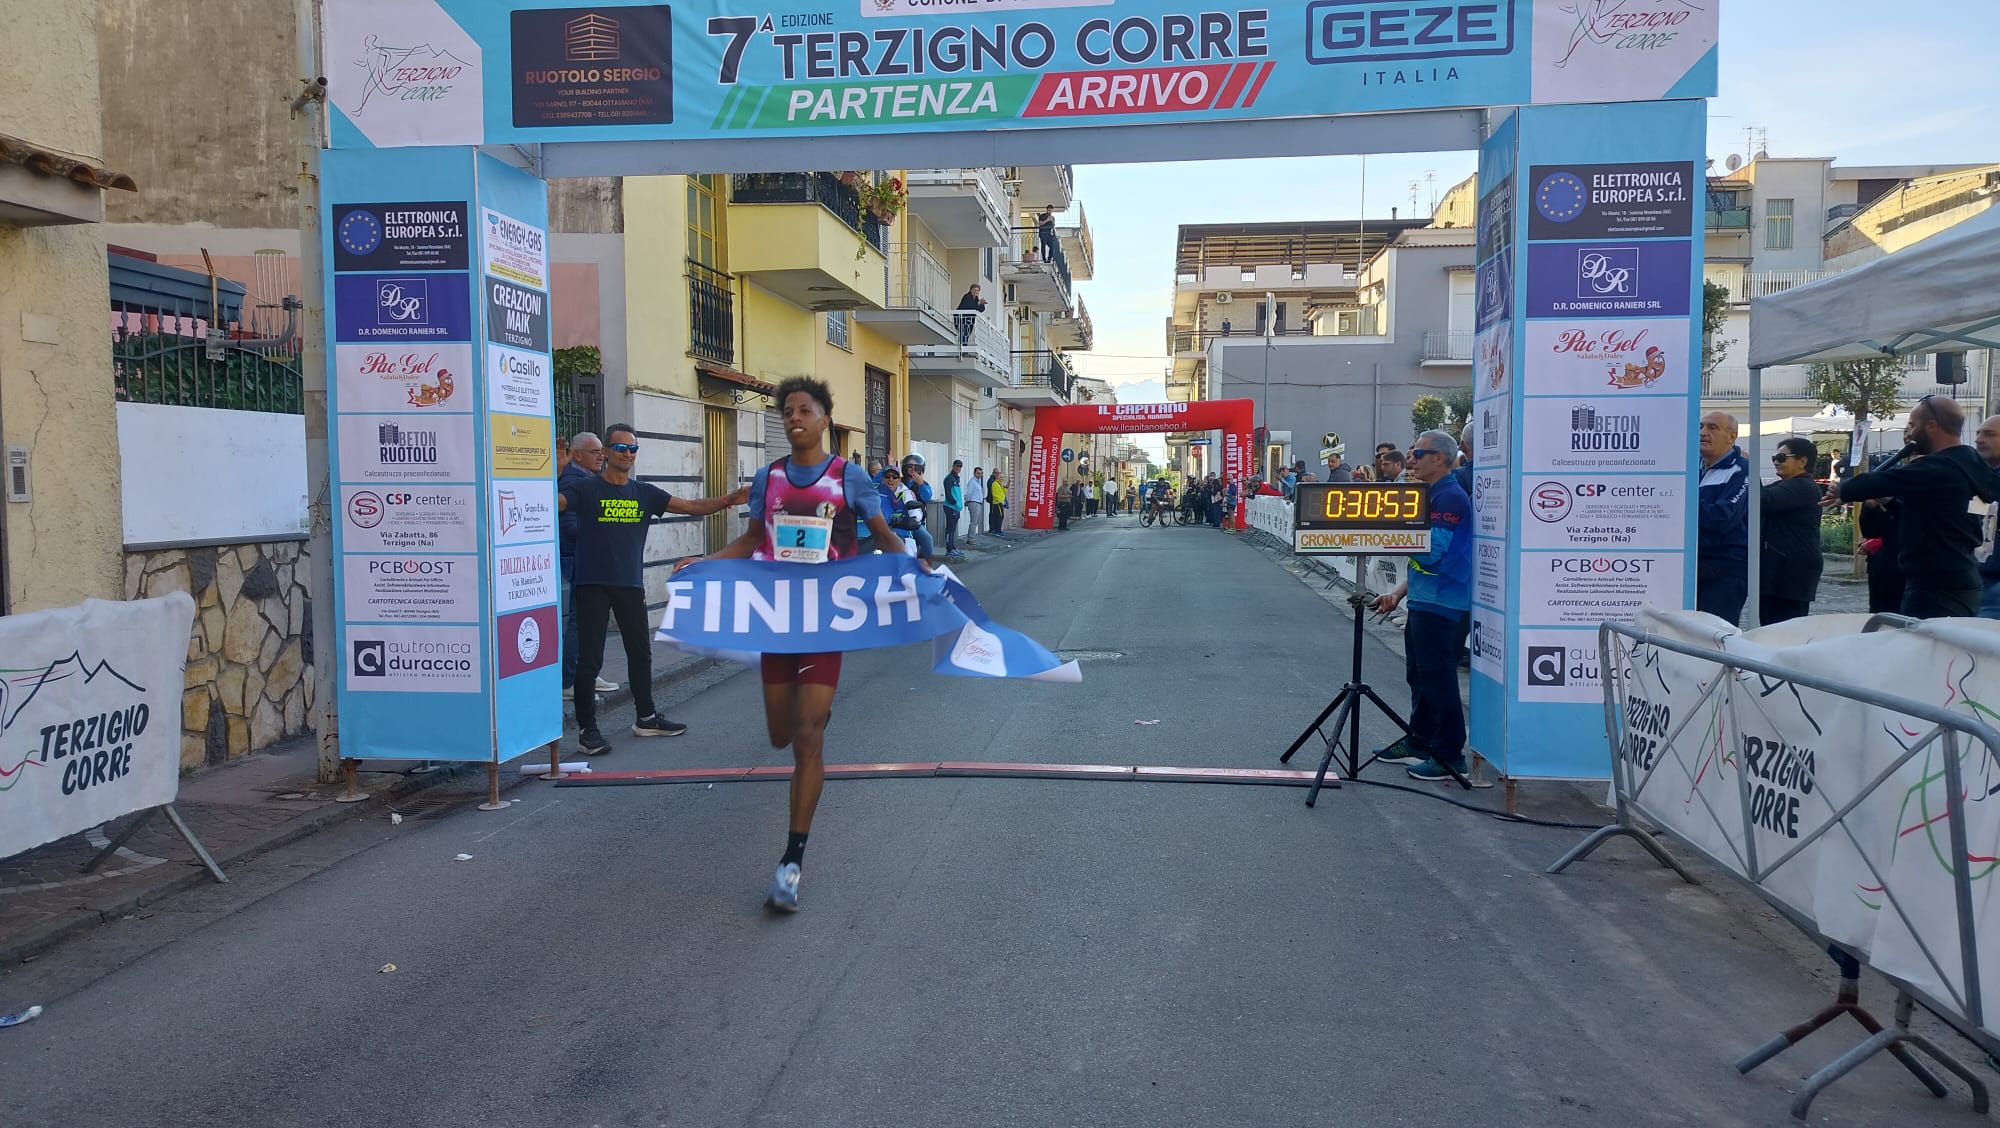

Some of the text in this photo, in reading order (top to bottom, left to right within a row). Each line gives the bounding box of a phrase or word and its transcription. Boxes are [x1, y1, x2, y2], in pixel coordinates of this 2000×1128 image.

[781, 12, 834, 28] EDIZIONE
[1322, 5, 1498, 50] GEZE
[1604, 11, 1690, 31] TERZIGNO
[772, 9, 1269, 80] TERZIGNO CORRE
[1616, 32, 1679, 50] CORRE
[391, 66, 462, 84] TERZIGNO
[525, 67, 662, 84] RUOTOLO SERGIO
[1363, 67, 1459, 86] ITALIA
[401, 86, 453, 101] CORRE
[575, 88, 602, 96] BUILDING
[1046, 70, 1209, 111] ARRIVO
[787, 81, 998, 121] PARTENZA
[1592, 171, 1682, 189] ELETTRONICA
[1592, 187, 1686, 204] EUROPEA S.r.l.
[385, 210, 458, 224] ELETTRONICA
[385, 224, 463, 239] EUROPEA S.r.l.
[500, 219, 542, 252] ENERGY-GAS
[493, 283, 542, 317] CREAZIONI
[1553, 301, 1662, 311] D.R. DOMENICO RANIERI SRL
[506, 309, 531, 334] MAIK
[358, 327, 448, 336] D.R. DOMENICO RANIERI SRL
[504, 332, 533, 347] TERZIGNO
[1553, 328, 1649, 353] Pac Gel
[359, 351, 439, 374] Pac Gel
[509, 356, 541, 377] Casillo
[1098, 402, 1188, 415] IL CAPITANO
[1098, 421, 1187, 432] www.ilcapitanoshop.it
[1595, 415, 1641, 432] BETON
[399, 431, 437, 446] BETON
[1571, 432, 1640, 450] RUOTOLO
[380, 446, 437, 463] RUOTOLO
[1552, 458, 1656, 468] Calcestruzzo preconfezionato
[1028, 435, 1044, 517] IL CAPITANO
[1047, 437, 1059, 518] www.ilcapitanoshop.it
[1575, 484, 1606, 497] CSP
[1611, 484, 1656, 497] center
[386, 493, 412, 505] CSP
[415, 493, 452, 506] center
[600, 499, 639, 508] TERZIGNO
[1325, 489, 1420, 519] 0:30:53
[380, 531, 393, 539] Via
[429, 531, 439, 539] 86
[796, 529, 806, 548] 2
[1566, 526, 1637, 535] Via Zabatta, 86
[383, 539, 434, 548] Terzigno (Na)
[1300, 532, 1427, 547] CRONOMETROGARA.IT
[1568, 535, 1632, 544] Terzigno (Na)
[500, 556, 526, 576] EDILIZIA
[508, 590, 536, 601] TERZIGNO
[658, 573, 922, 635] FINISH
[1547, 599, 1600, 607] CARTOTECNICA
[388, 640, 471, 654] autronica
[389, 655, 471, 671] duraccio
[39, 703, 149, 762] TERZIGNO
[61, 742, 133, 796] CORRE
[1742, 731, 1815, 795] RZIGNO
[1748, 781, 1800, 839] ORRE
